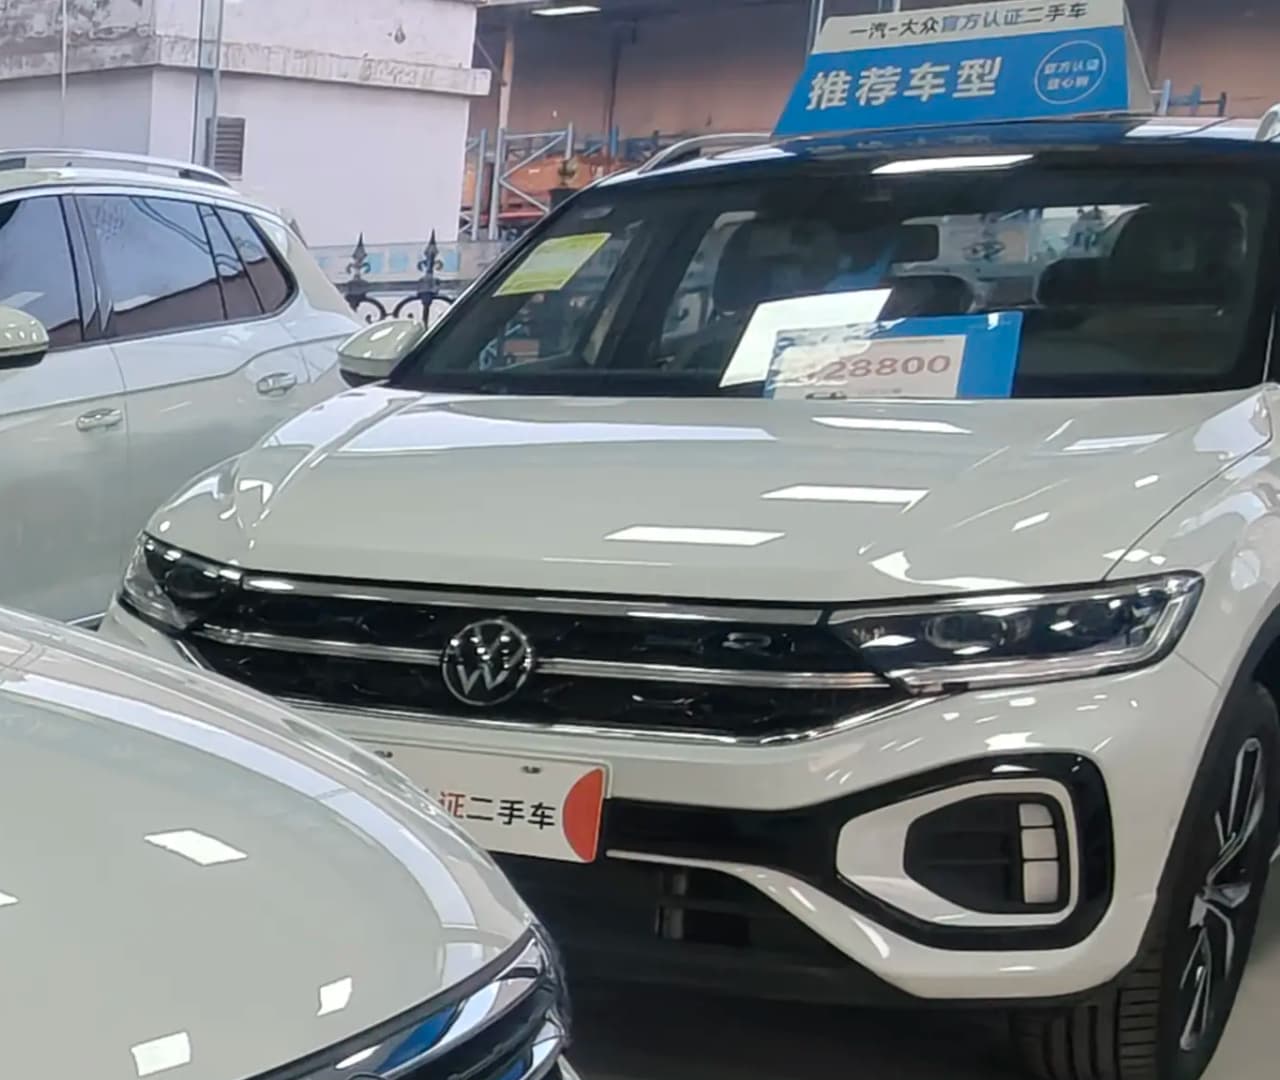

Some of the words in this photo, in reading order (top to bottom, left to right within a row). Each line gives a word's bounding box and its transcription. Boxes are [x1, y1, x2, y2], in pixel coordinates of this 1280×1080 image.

[850, 2, 1088, 39] 一汽-大众官方认证二手车
[806, 56, 1002, 110] 推荐车型
[806, 355, 951, 382] 28800
[424, 789, 556, 830] 证二手车
